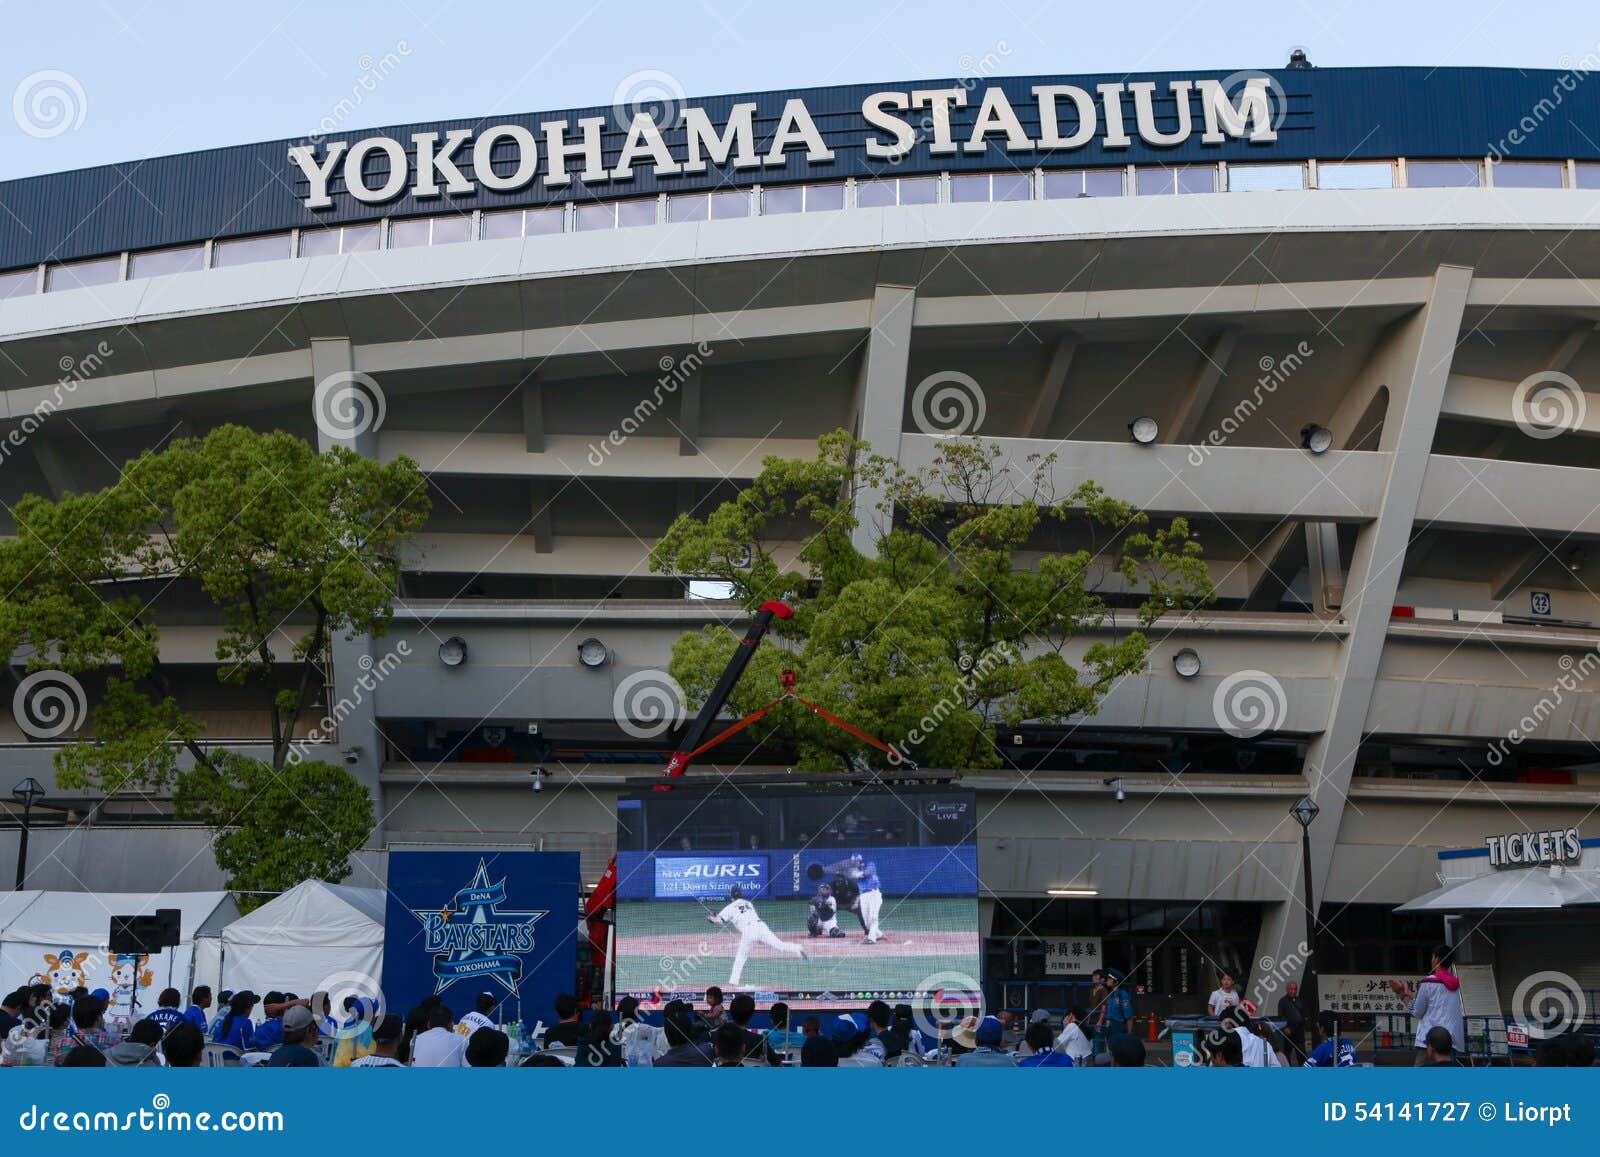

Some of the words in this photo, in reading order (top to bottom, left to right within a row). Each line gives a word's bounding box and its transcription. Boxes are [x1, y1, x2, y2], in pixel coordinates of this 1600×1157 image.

[288, 98, 835, 208] YOKOHAMA
[861, 77, 1278, 158] STADIUM
[1534, 595, 1548, 607] 22
[1485, 827, 1581, 866] TICKETS
[683, 863, 761, 878] AURIS
[470, 893, 491, 901] DeNA
[425, 912, 535, 952] BAYSTARS
[454, 960, 501, 973] YOKOHAMA
